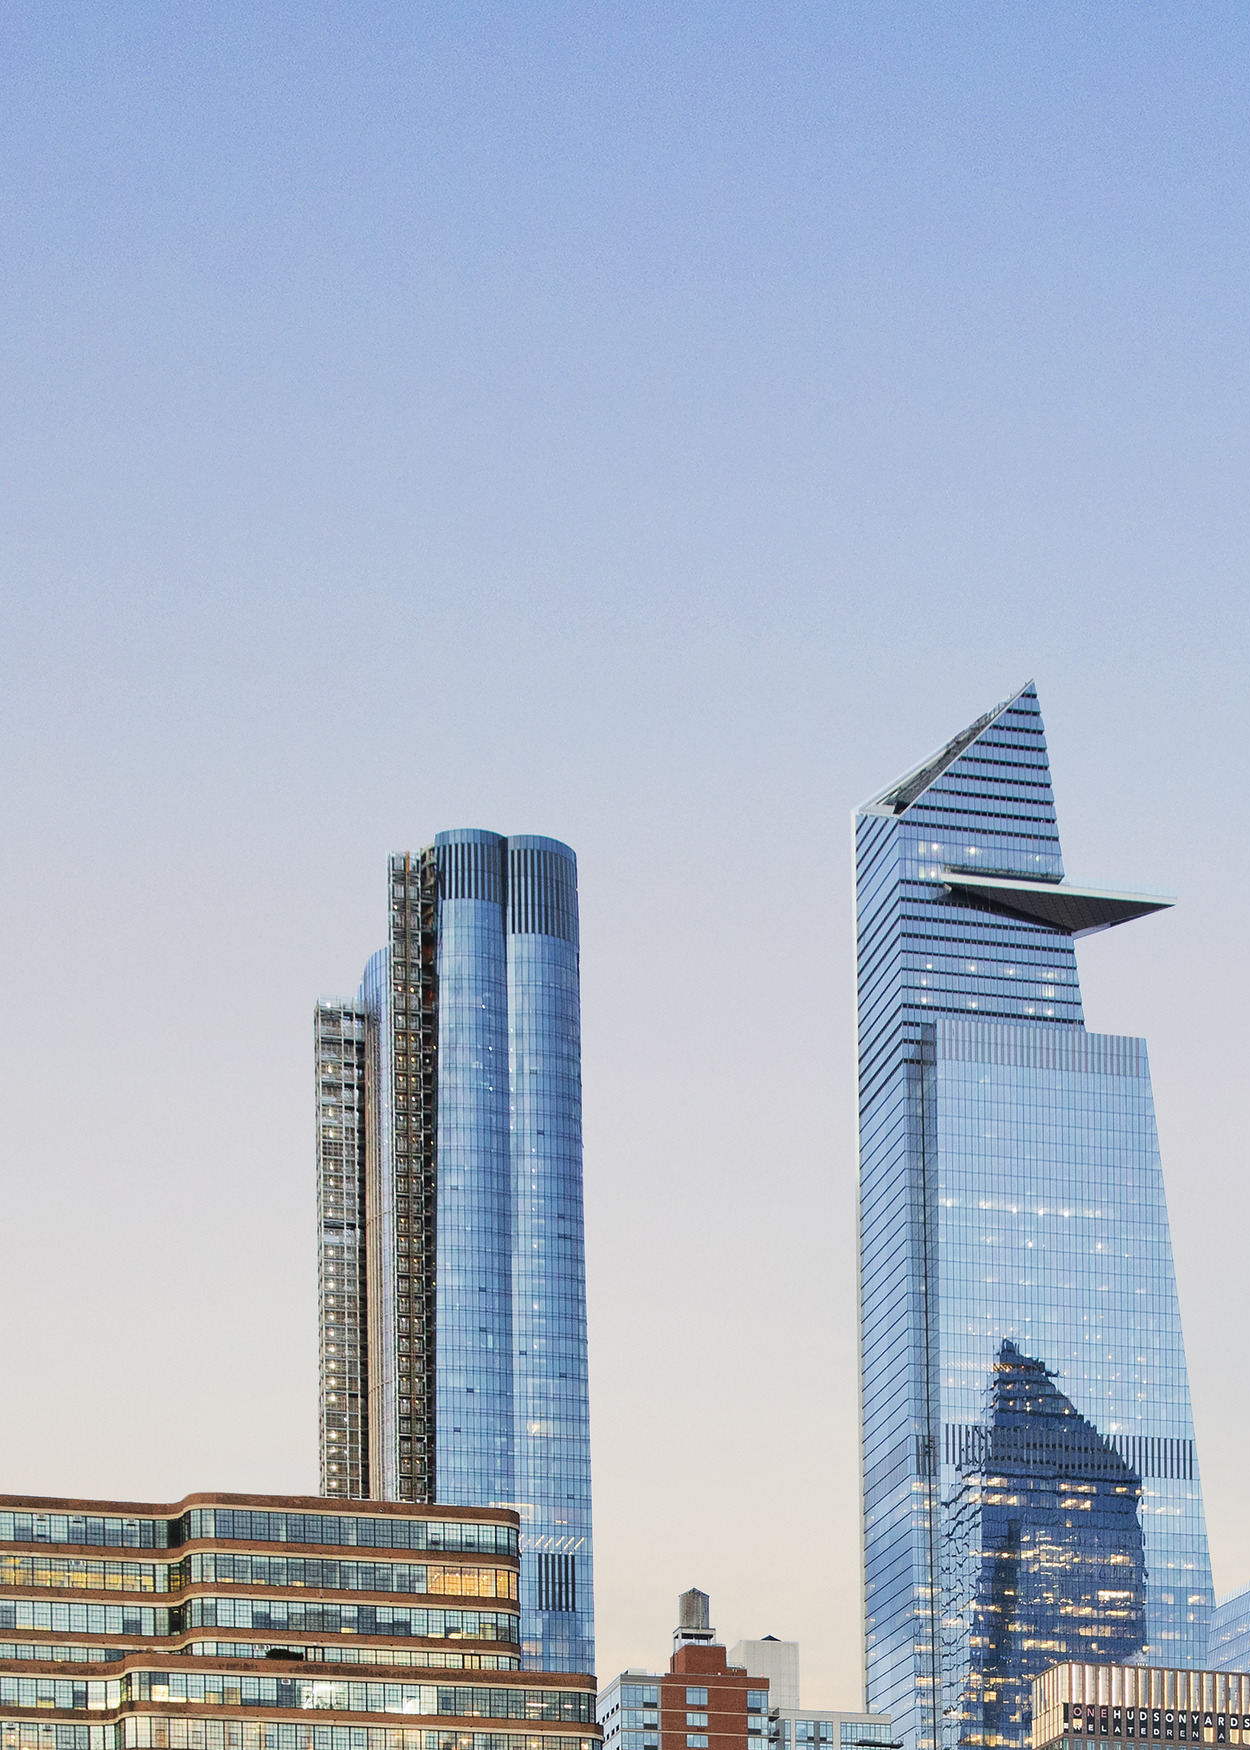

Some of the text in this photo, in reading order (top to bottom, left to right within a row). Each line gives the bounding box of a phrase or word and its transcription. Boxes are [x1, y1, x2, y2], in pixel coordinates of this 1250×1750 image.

[1073, 1706, 1250, 1729] ONE HUDSON YARDS
